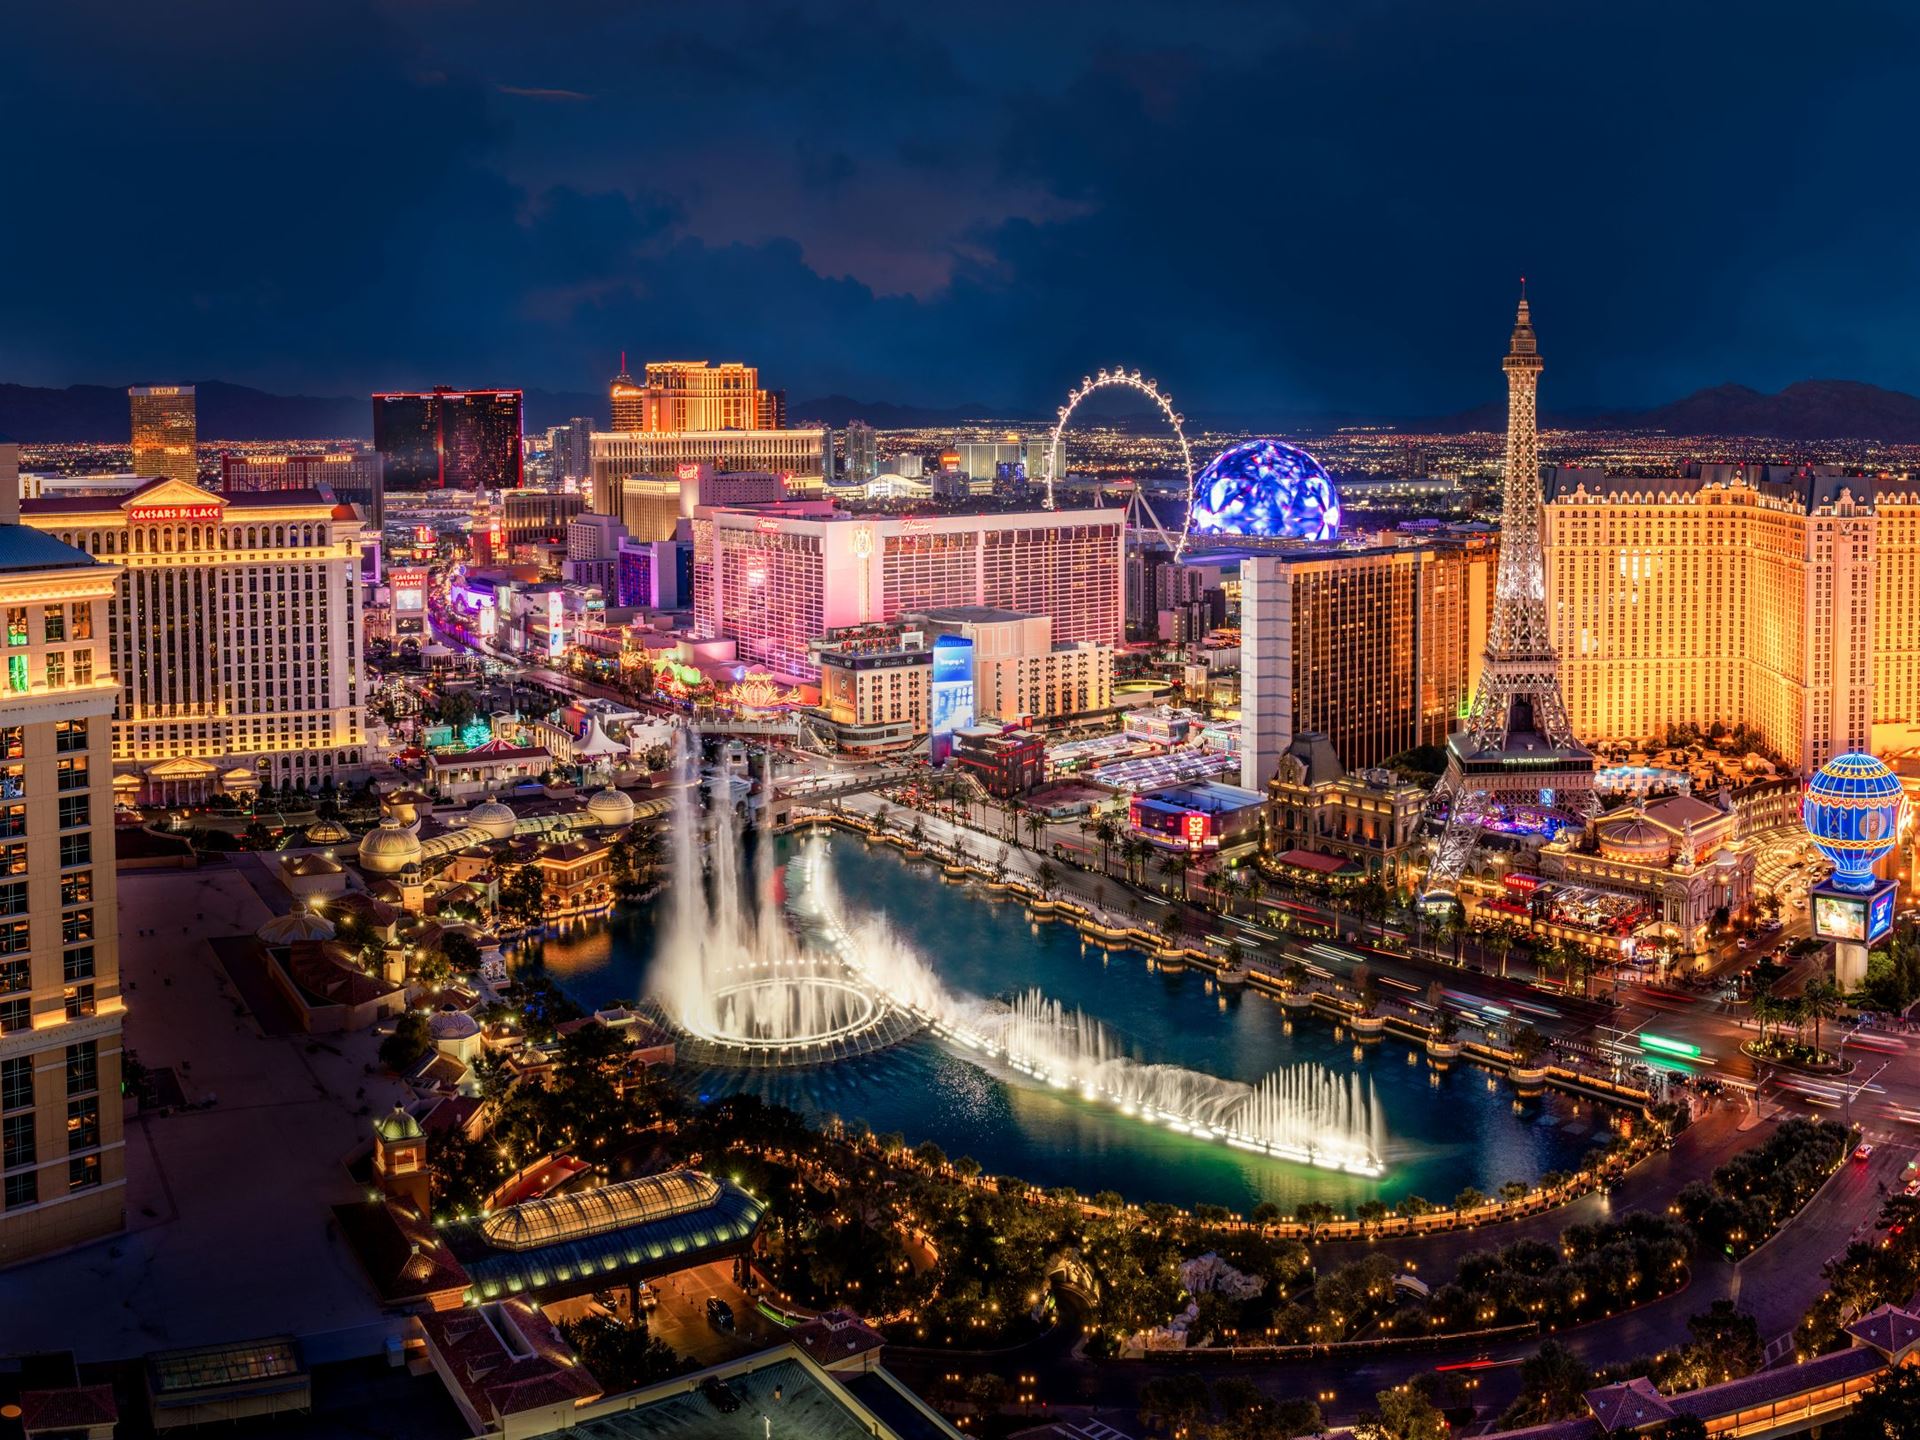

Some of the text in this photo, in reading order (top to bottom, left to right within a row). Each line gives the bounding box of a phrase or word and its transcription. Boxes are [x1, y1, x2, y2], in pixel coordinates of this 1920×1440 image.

[150, 387, 179, 396] TRUMP
[247, 454, 352, 464] TREASURE ISLAND
[131, 507, 219, 519] CAESARS PALACE
[1505, 877, 1535, 888] BEER PARK
